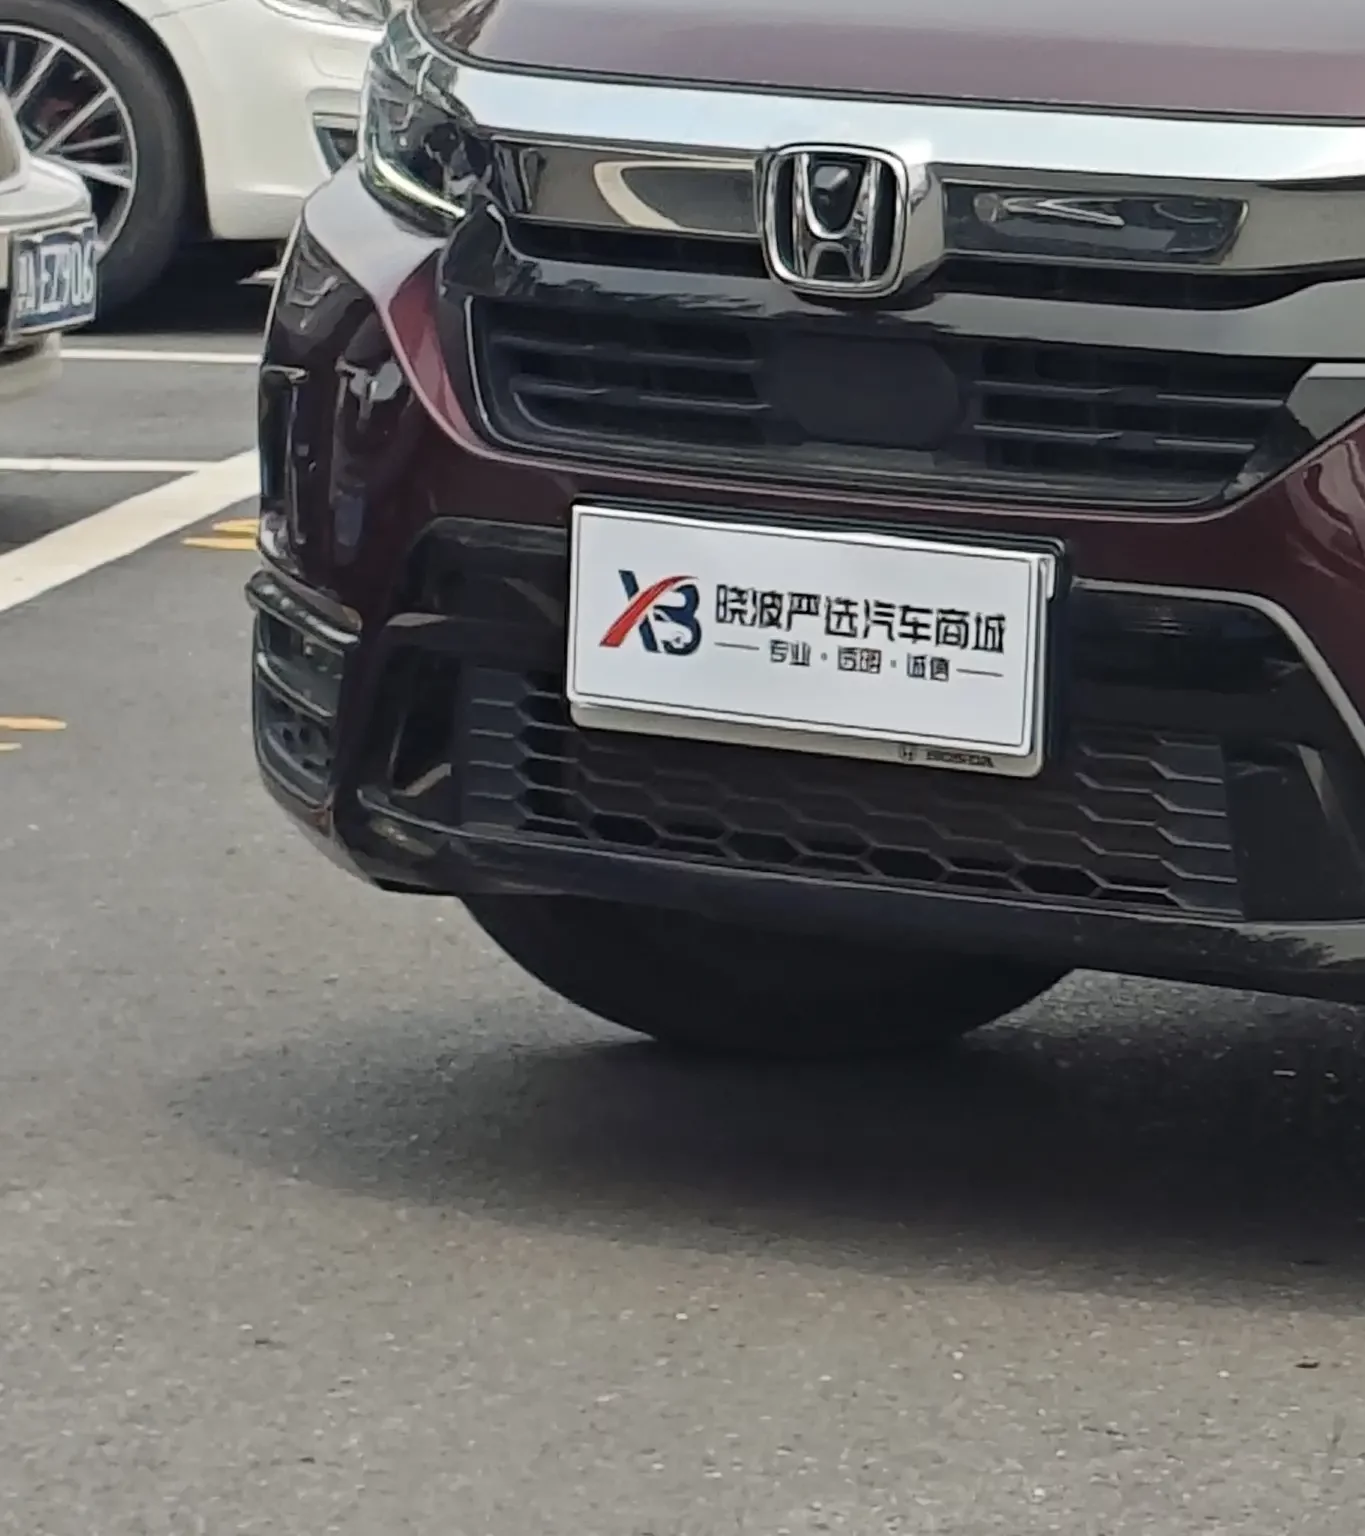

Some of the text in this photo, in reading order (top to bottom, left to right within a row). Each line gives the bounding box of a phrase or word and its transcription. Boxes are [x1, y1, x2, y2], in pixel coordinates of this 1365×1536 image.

[715, 583, 1006, 654] 晓波严选汽车商城
